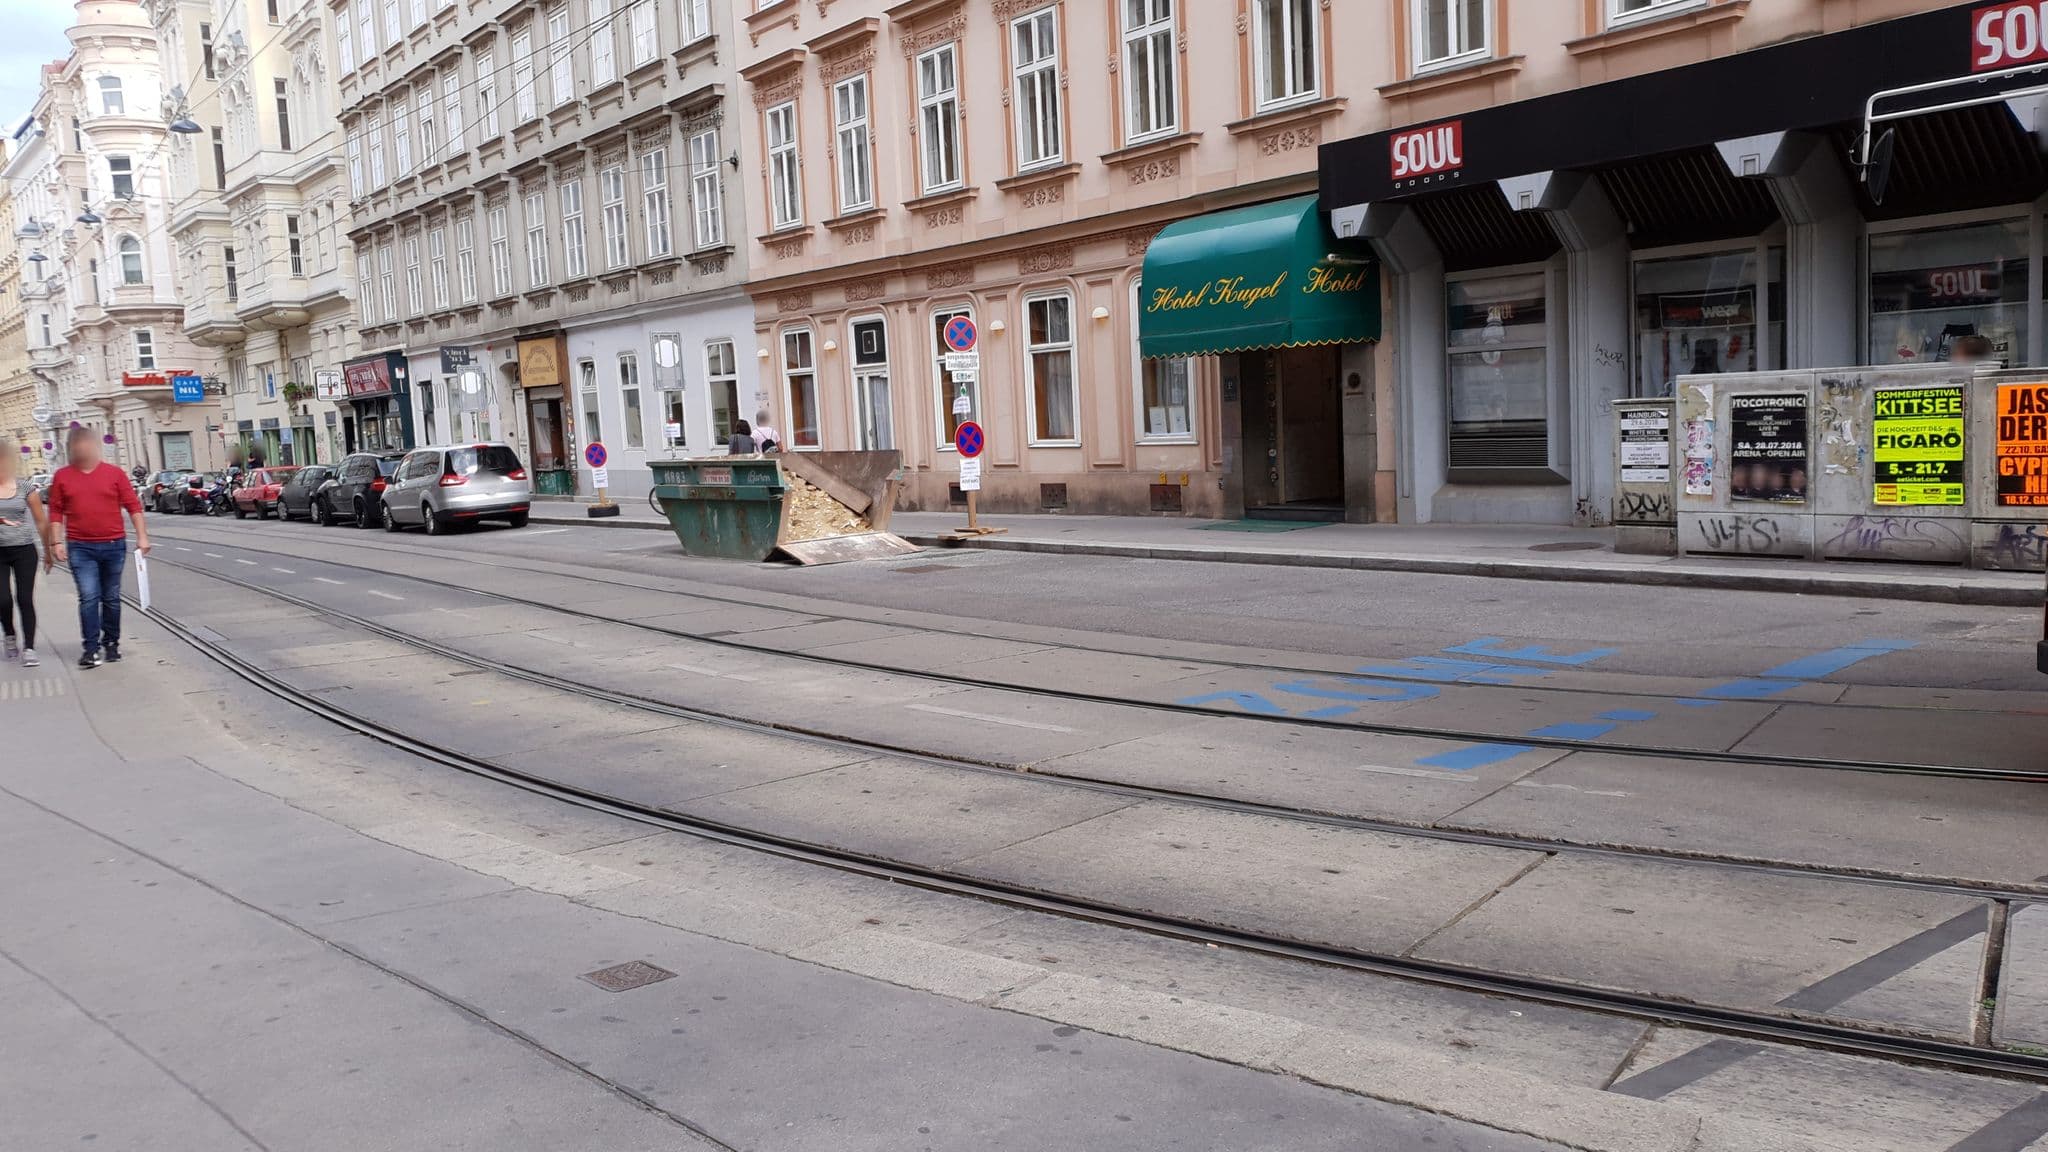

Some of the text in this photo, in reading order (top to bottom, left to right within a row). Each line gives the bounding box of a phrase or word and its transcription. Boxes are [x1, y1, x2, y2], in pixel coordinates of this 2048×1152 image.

[1977, 5, 2048, 66] SO
[1393, 127, 1461, 176] SOUL
[1303, 267, 1369, 293] Hotel
[1930, 269, 1987, 297] SOUL
[1147, 271, 1288, 313] Hotel Kugel
[1876, 388, 1962, 400] SOMMERFESTIVAL
[2008, 387, 2048, 415] JAS
[1876, 397, 1962, 415] KITTSEE
[2000, 415, 2048, 441] DER
[1755, 441, 1802, 449] 28.07.2018
[1877, 432, 1962, 449] FIGARO
[2005, 445, 2048, 454] 22.10. GA
[1889, 463, 1903, 475] 5.
[1915, 462, 1948, 474] 21.7.
[2033, 495, 2048, 505] GA
